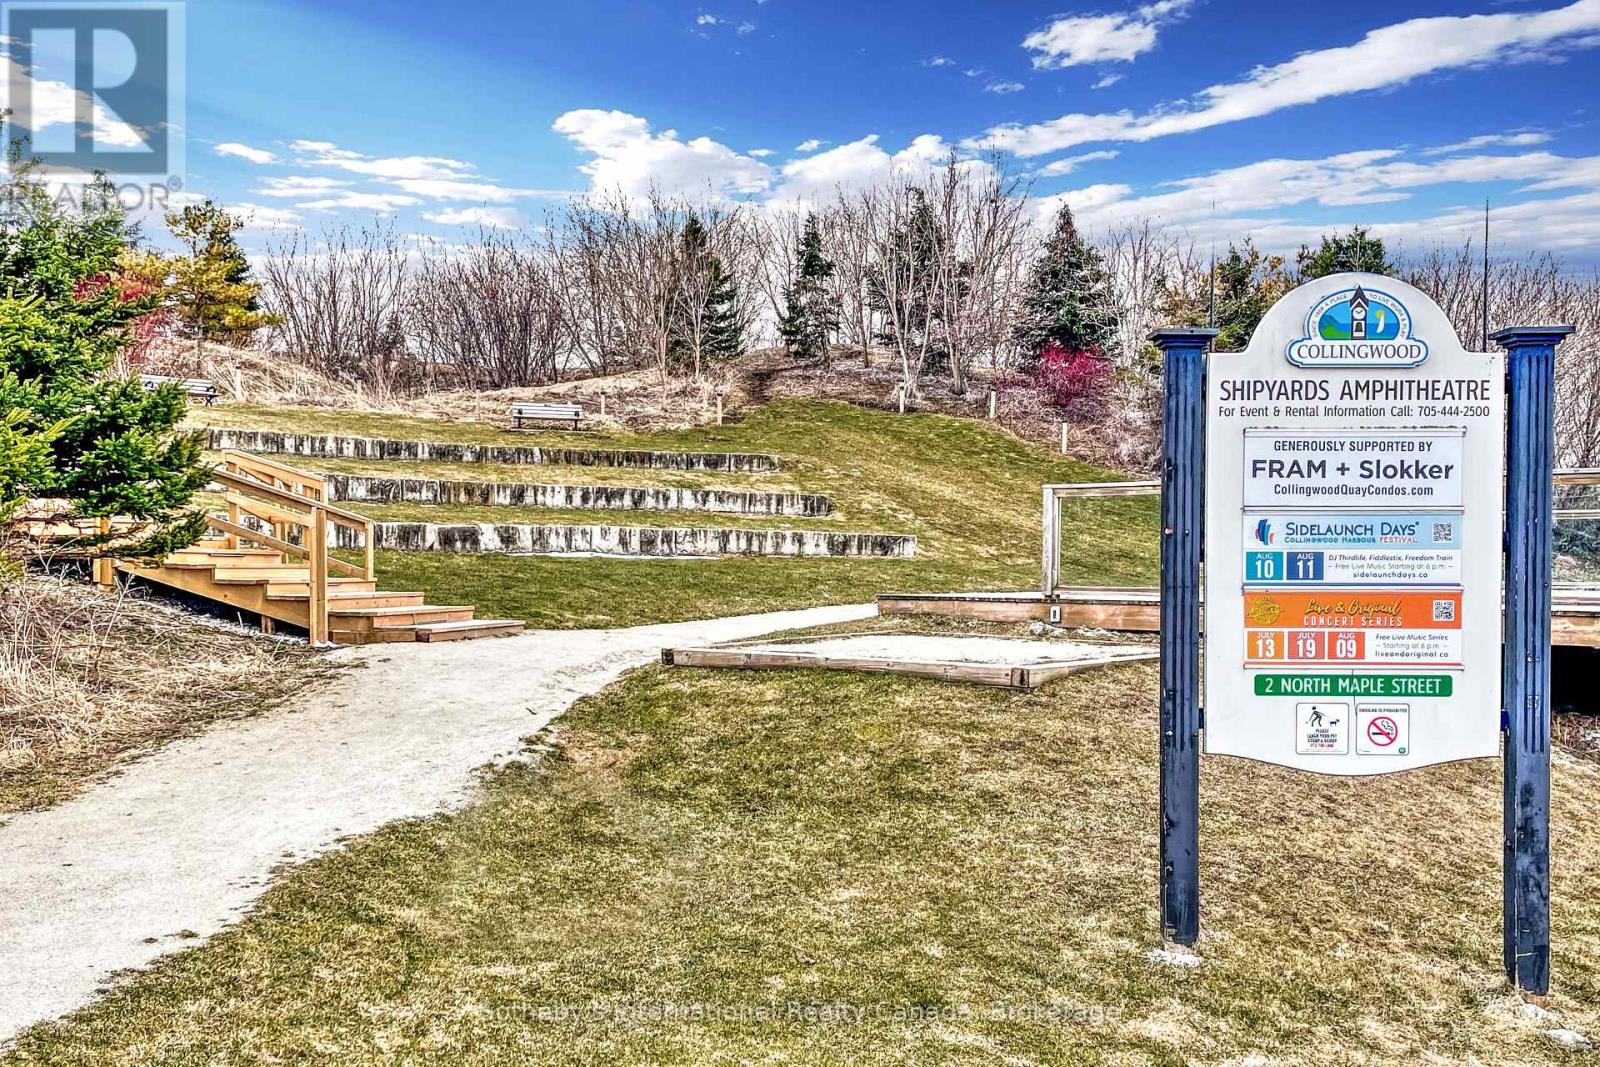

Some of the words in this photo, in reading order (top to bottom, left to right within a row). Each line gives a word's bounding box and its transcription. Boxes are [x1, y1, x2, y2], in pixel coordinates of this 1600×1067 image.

[1297, 344, 1421, 359] COLLINGWOOD
[1219, 379, 1330, 401] SHIPYARDS
[1339, 379, 1491, 401] AMPHITHEATRE
[1219, 405, 1236, 417] For
[1240, 405, 1271, 417] Event
[1273, 405, 1281, 417] &
[1285, 405, 1319, 417] Rental
[1323, 405, 1386, 417] Information
[1390, 405, 1414, 417] Call:
[1418, 405, 1490, 417] 705-444-2500
[1273, 440, 1346, 452] GENEROUSLY
[1349, 440, 1415, 452] SUPPORTED
[1418, 440, 1433, 452] BY
[1251, 459, 1327, 479] FRAM
[1336, 462, 1350, 476] +
[1359, 459, 1454, 479] Slokker
[1273, 484, 1434, 497] CollingwoodQuayCondos.com
[1285, 521, 1374, 536] SIDELAUNCH
[1284, 536, 1339, 544] COLLINGWOOD
[1342, 536, 1376, 544] HARBOUR
[1379, 536, 1418, 544] FESTIVAL
[1255, 560, 1275, 579] 10
[1296, 560, 1314, 579] 11
[1388, 563, 1415, 571] Starting
[1304, 598, 1332, 614] Live
[1335, 602, 1345, 613] &
[1348, 597, 1402, 619] Original
[1303, 616, 1355, 627] CONCERT
[1361, 616, 1403, 627] SERIES
[1375, 633, 1391, 641] Free
[1391, 633, 1406, 641] Live
[1406, 633, 1427, 641] Music
[1428, 633, 1449, 641] Series
[1255, 640, 1275, 658] 13
[1296, 640, 1316, 658] 19
[1336, 640, 1357, 658] 09
[1382, 642, 1410, 650] Starting
[1264, 678, 1274, 693] 2
[1280, 678, 1330, 693] NORTH
[1338, 678, 1385, 693] MAPLE
[1391, 678, 1442, 694] STREET
